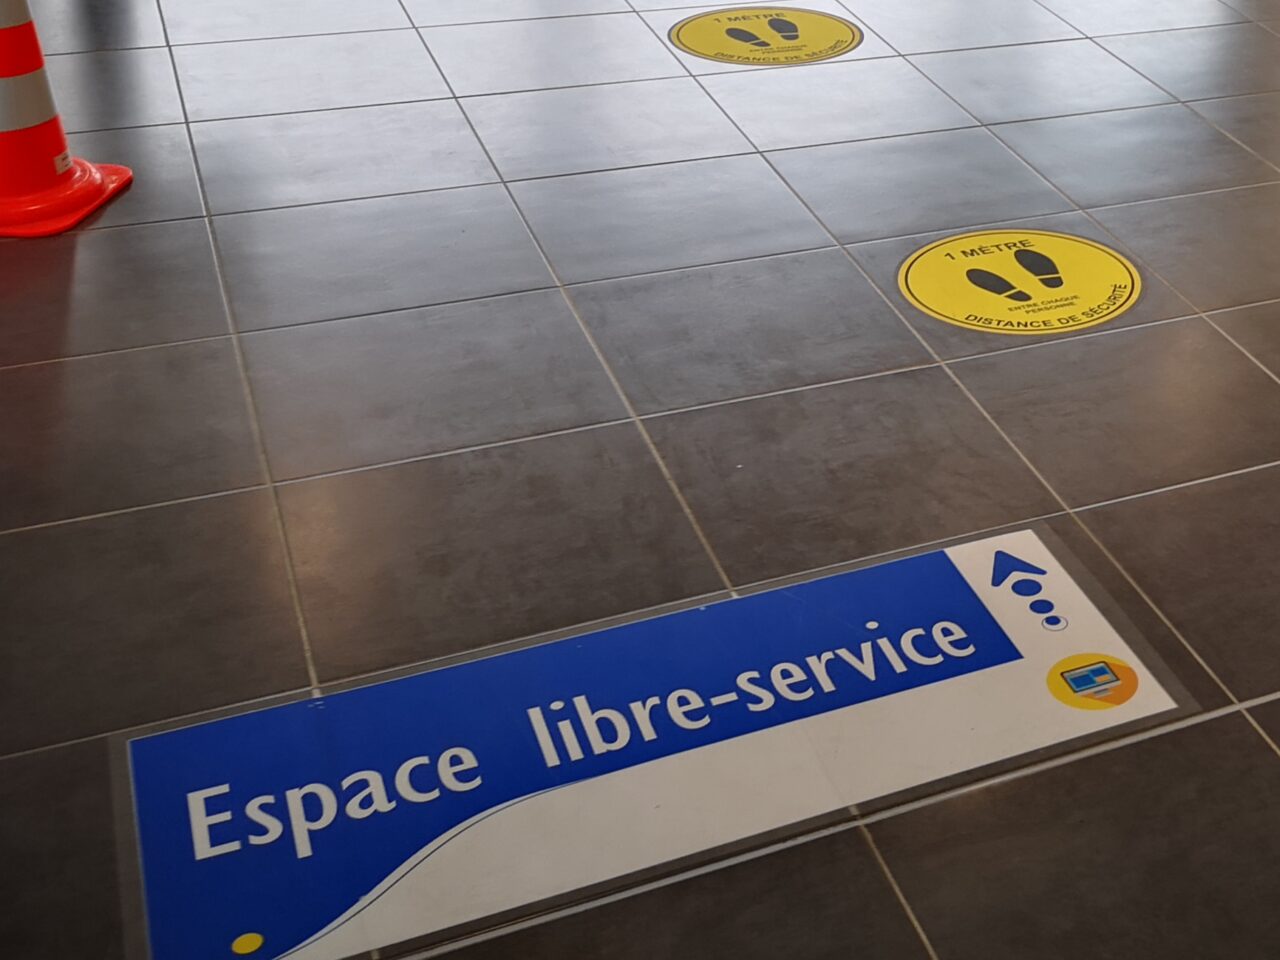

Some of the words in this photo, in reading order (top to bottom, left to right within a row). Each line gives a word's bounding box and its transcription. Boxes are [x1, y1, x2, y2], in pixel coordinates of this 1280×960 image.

[714, 51, 781, 62] DISTANCE
[945, 252, 956, 260] 1
[961, 239, 1036, 258] MÈTRE
[964, 314, 1052, 329] DISTANCE
[1056, 314, 1083, 325] DE
[1081, 284, 1128, 319] SÉCURITÉ
[1008, 302, 1038, 312] ENTRE
[1041, 295, 1080, 306] CHAQUE
[186, 746, 483, 862] Espace
[526, 617, 977, 769] libre-service
